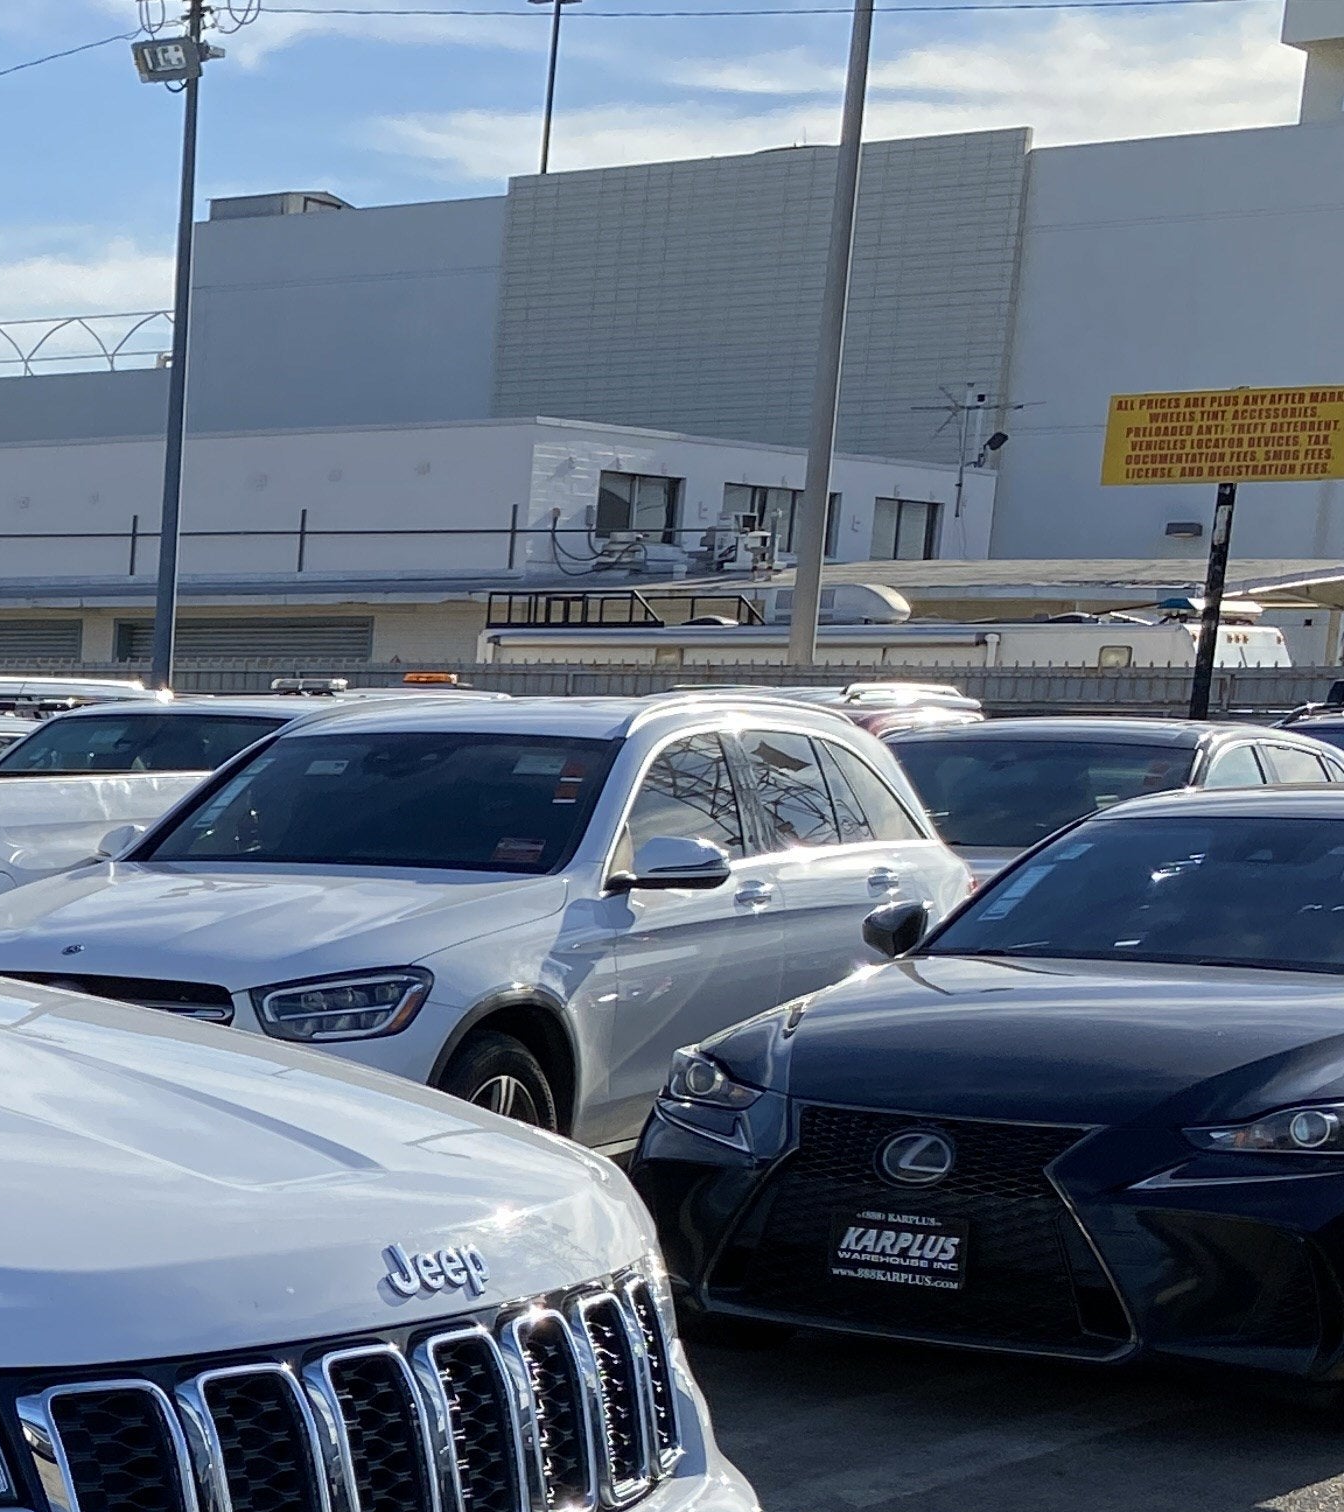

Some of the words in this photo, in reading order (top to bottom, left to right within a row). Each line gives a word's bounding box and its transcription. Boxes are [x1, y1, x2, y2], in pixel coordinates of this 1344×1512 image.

[1116, 400, 1135, 411] ALL
[1139, 397, 1181, 411] PRICES
[1184, 397, 1208, 409] ARE
[1210, 395, 1239, 408] PLUS
[1242, 394, 1267, 406] ANY
[1268, 392, 1306, 405] AFTER
[1125, 425, 1194, 438] PRELOADED
[1131, 438, 1187, 452] VEHICLES
[1190, 437, 1244, 450] LOCATOR
[1125, 451, 1226, 466] DOCUMENTATION
[1263, 449, 1300, 461] SMOG
[1179, 466, 1204, 478] AND
[1207, 463, 1297, 477] REGISTRATION
[840, 1226, 960, 1261] KARPLUS
[837, 1250, 929, 1268] WAREHOUSE
[932, 1261, 959, 1271] INC
[383, 1242, 490, 1298] Jeep
